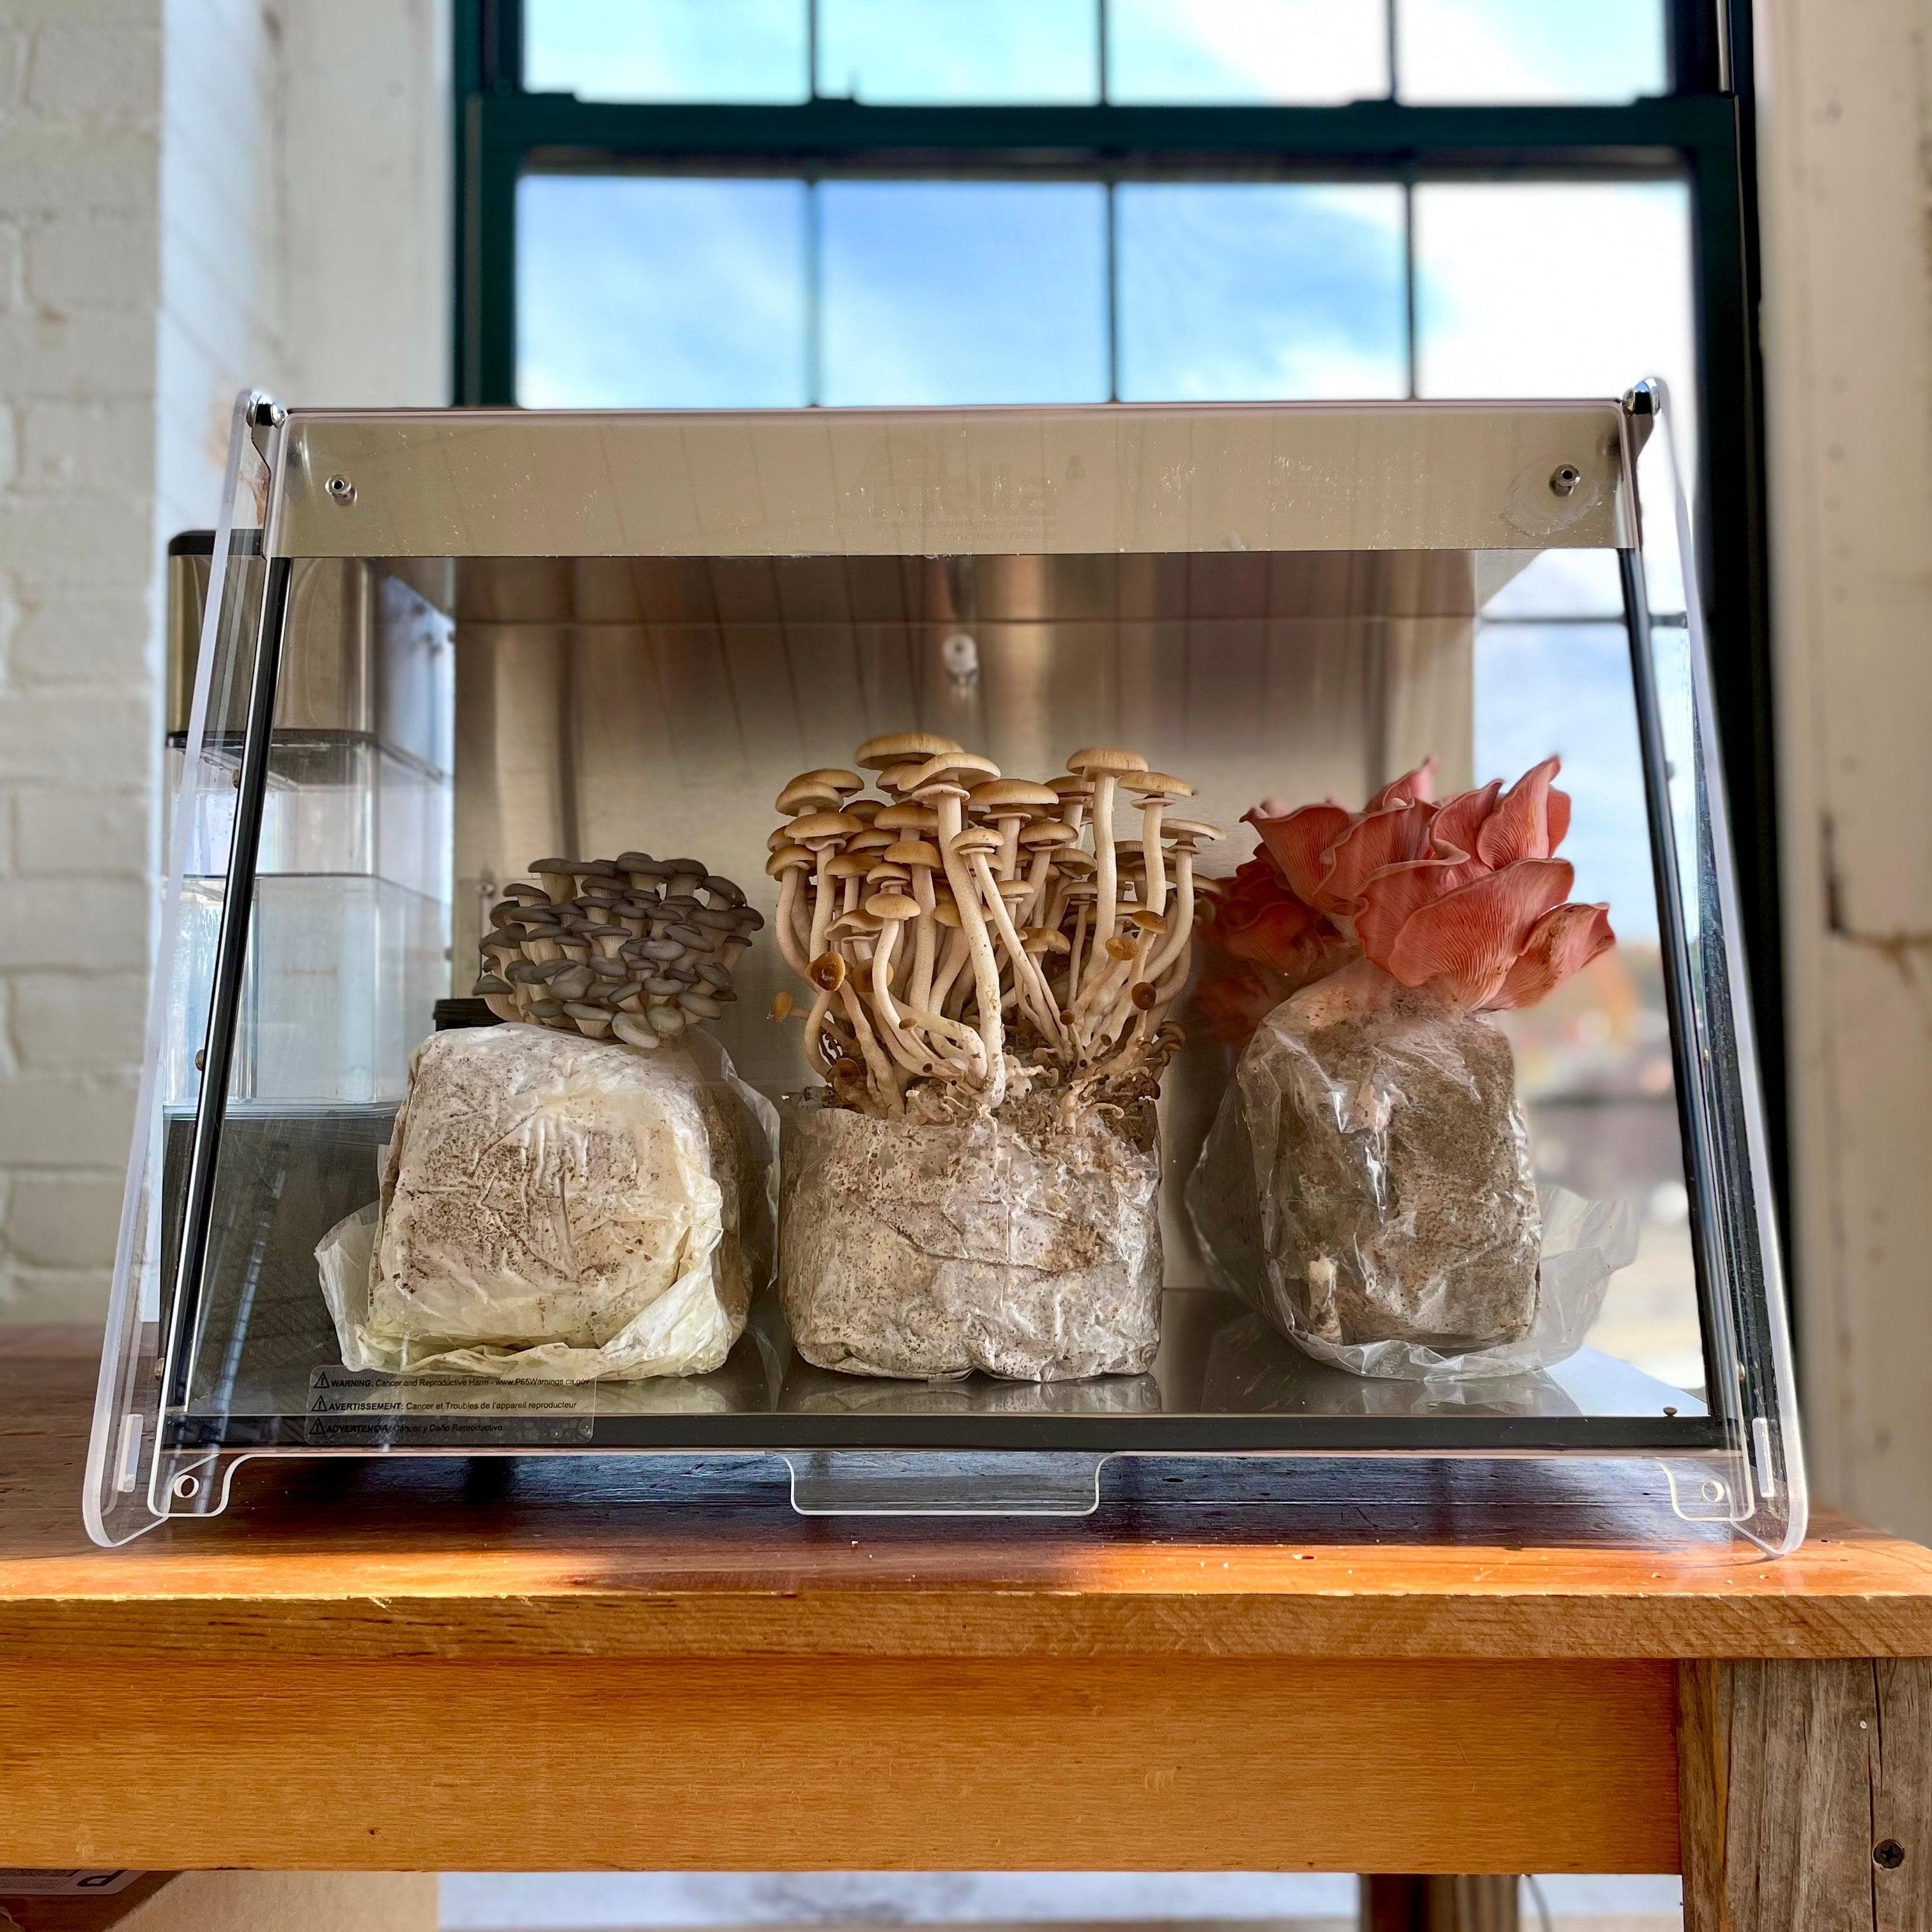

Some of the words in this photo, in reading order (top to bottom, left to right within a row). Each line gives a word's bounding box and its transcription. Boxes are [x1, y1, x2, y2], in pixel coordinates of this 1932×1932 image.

[419, 1379, 467, 1388] Reproductive
[328, 1402, 404, 1411] AVERTISSEMENT:
[406, 1402, 434, 1410] Cancer
[445, 1402, 479, 1410] Troubles
[492, 1401, 526, 1411] l'appareil
[528, 1401, 578, 1411] reproducteur
[423, 1425, 427, 1434] y
[452, 1424, 503, 1433] Reproductivo
